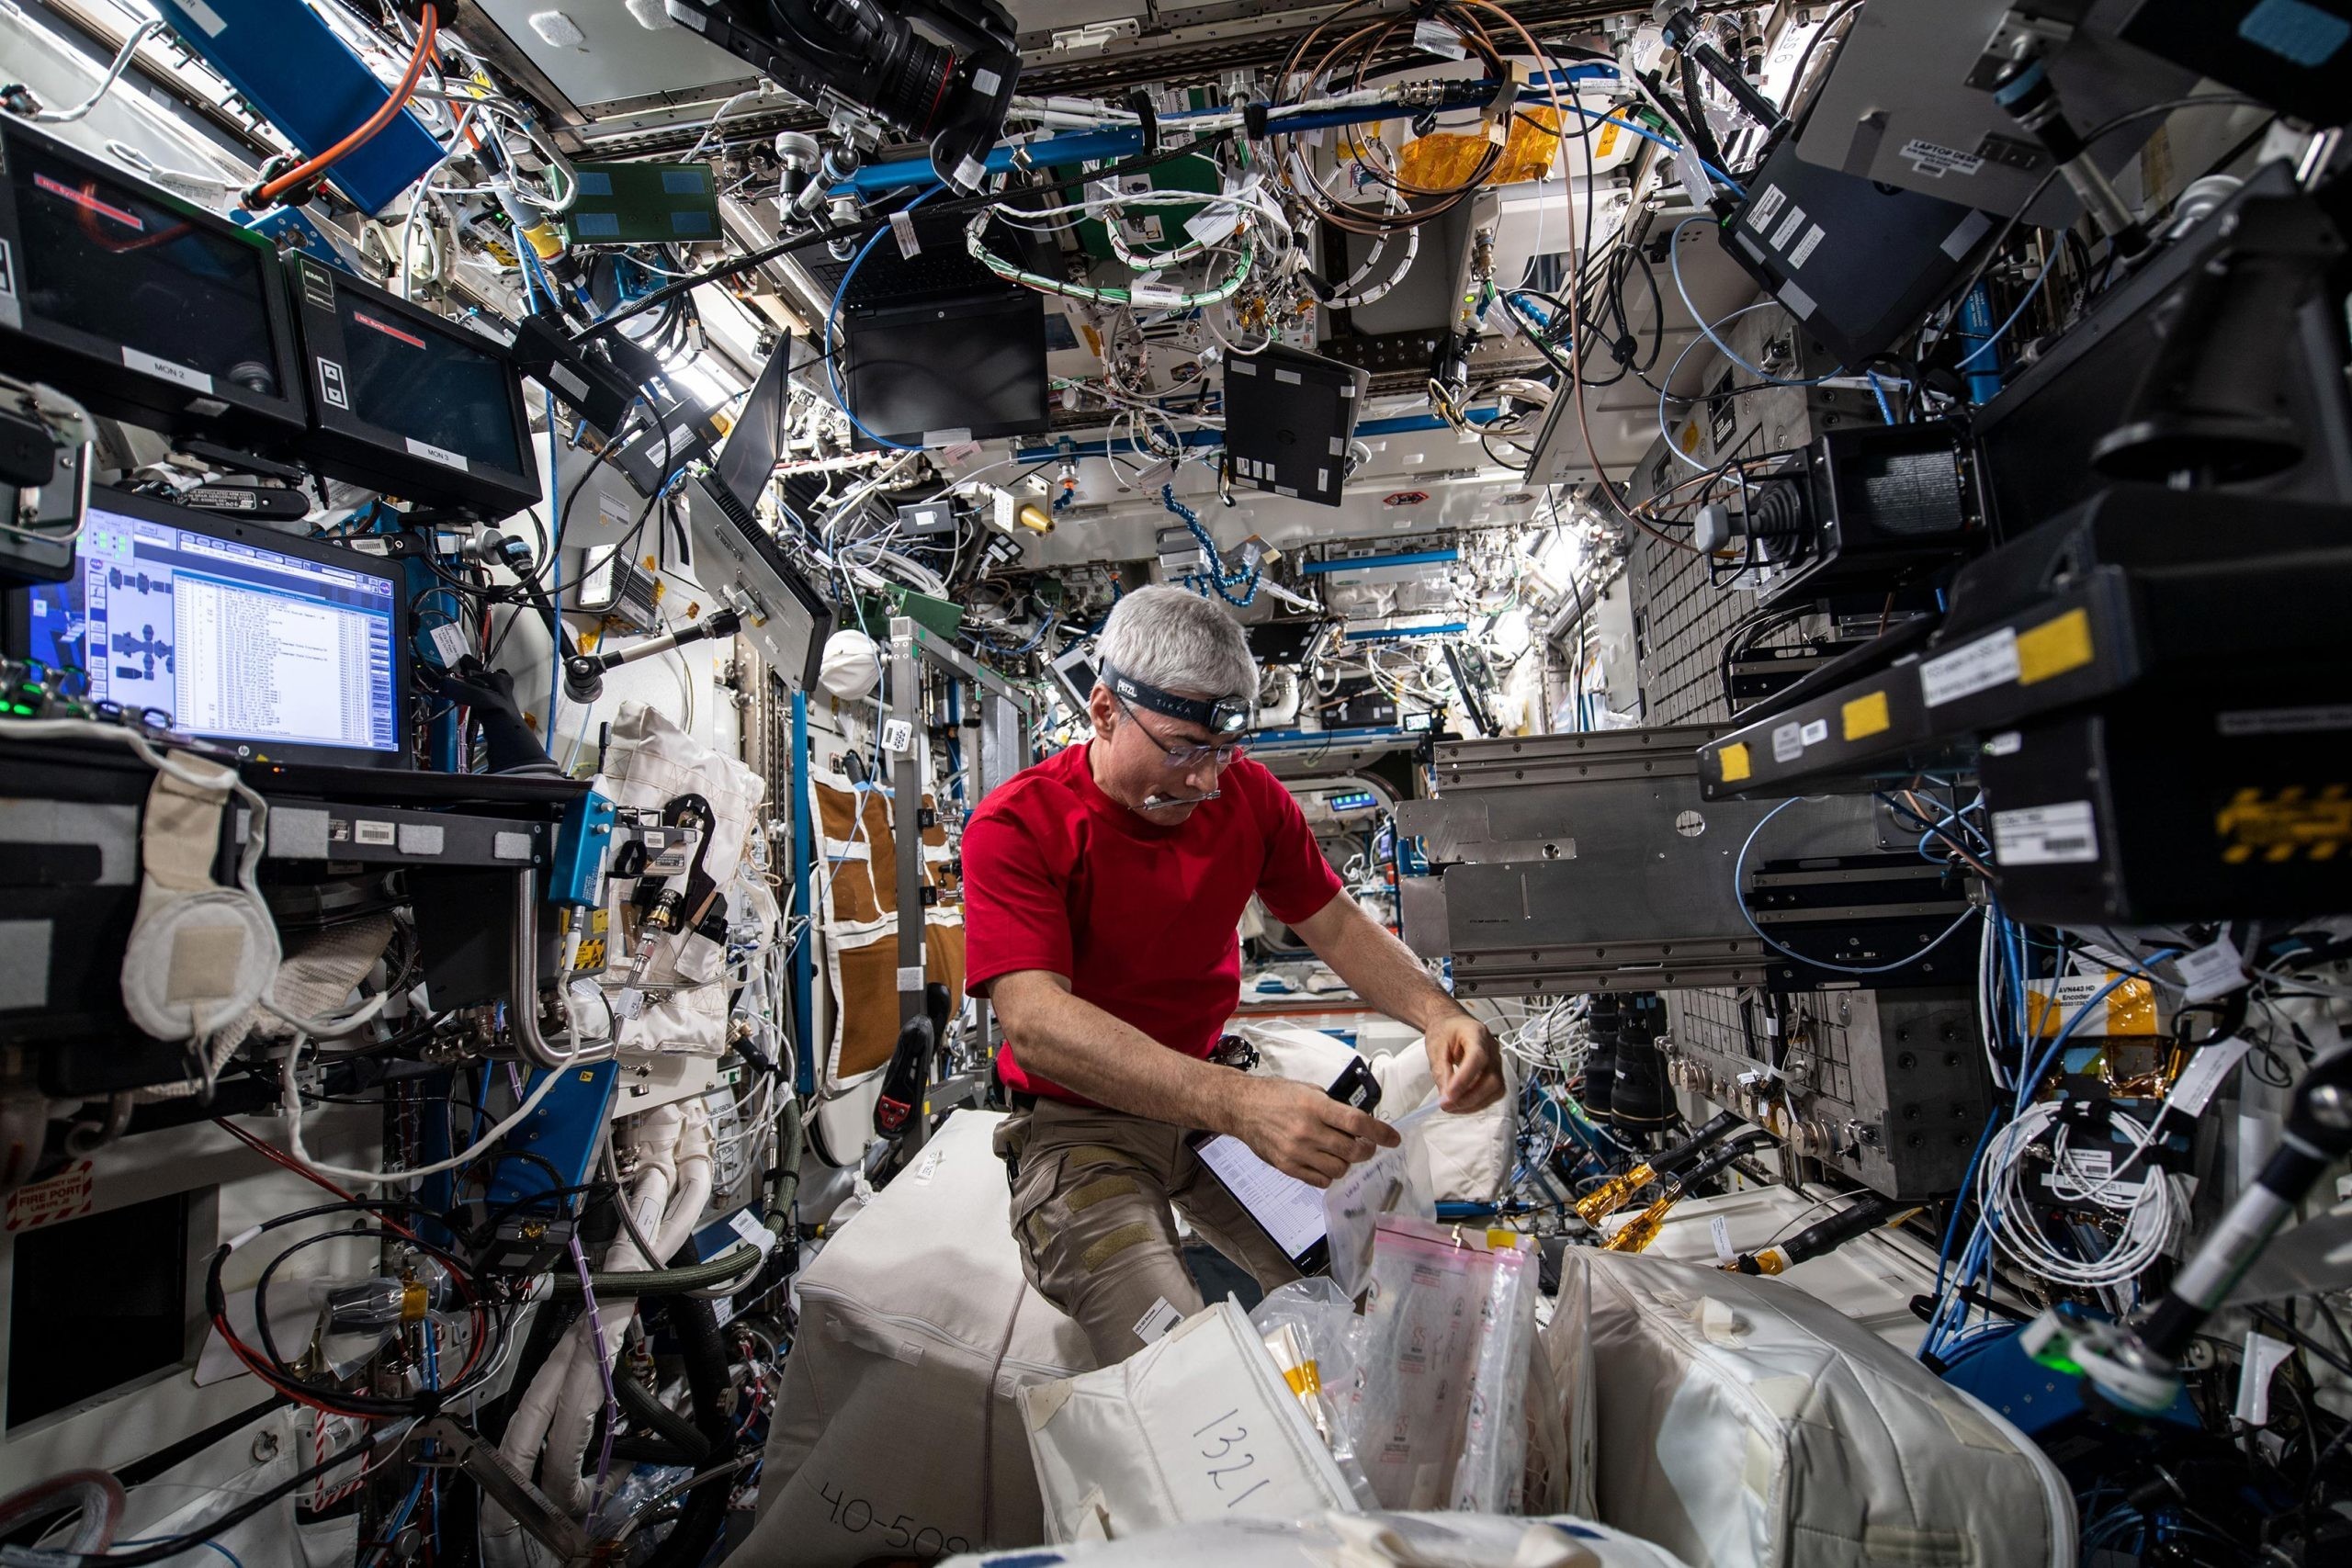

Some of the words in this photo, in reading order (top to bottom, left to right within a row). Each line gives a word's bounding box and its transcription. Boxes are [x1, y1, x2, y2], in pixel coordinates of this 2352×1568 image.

[1914, 141, 1952, 157] LAPTOP
[1953, 151, 1979, 164] DESK
[154, 363, 175, 378] MON
[427, 449, 443, 459] MON
[1117, 680, 1137, 697] PETZL
[1157, 699, 1191, 713] TIKKA
[238, 745, 249, 756] hp
[2063, 993, 2090, 1001] Encoder
[19, 1192, 45, 1206] FIRE
[50, 1184, 81, 1200] PORT
[1193, 1408, 1270, 1508] 1321
